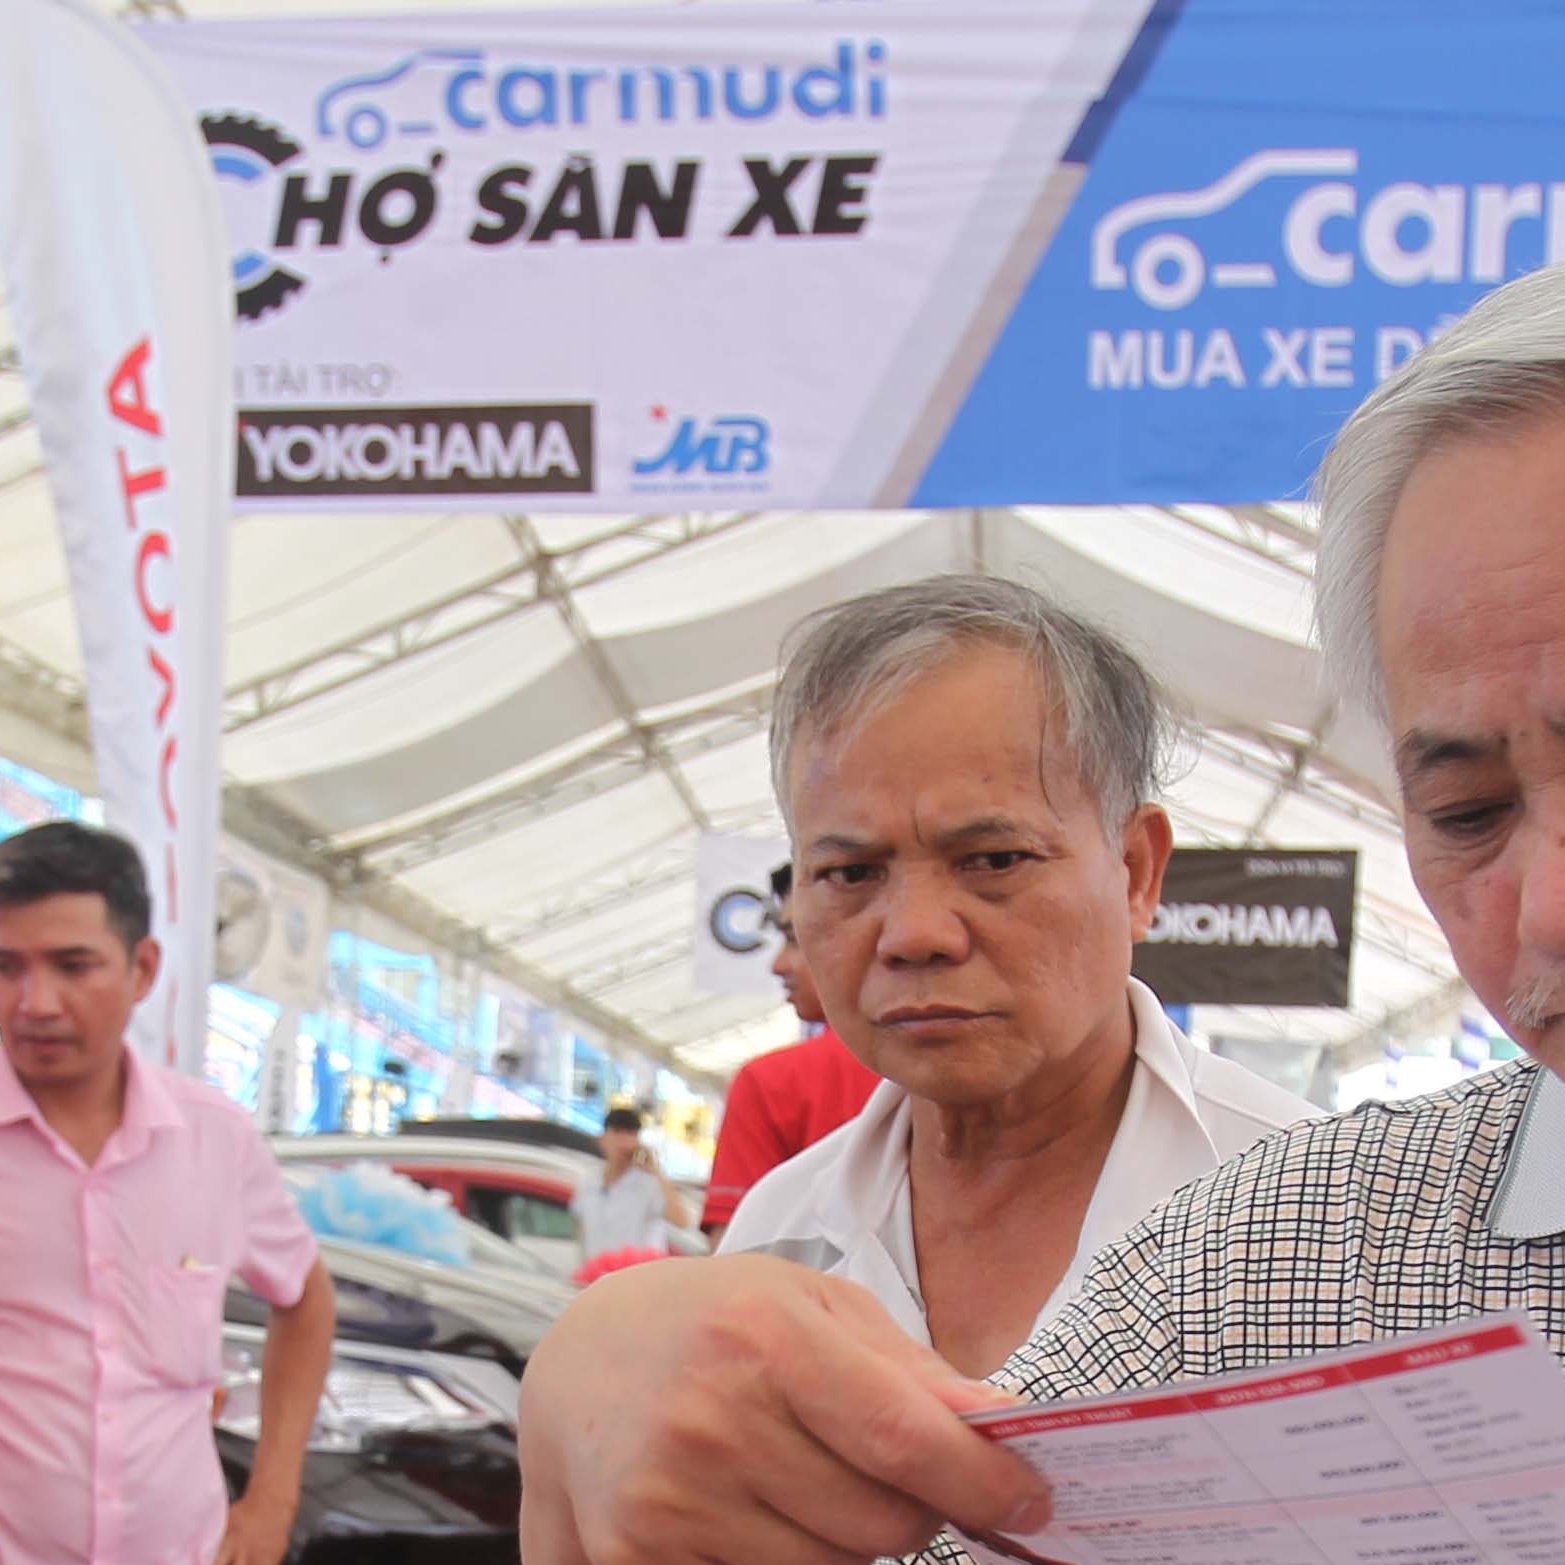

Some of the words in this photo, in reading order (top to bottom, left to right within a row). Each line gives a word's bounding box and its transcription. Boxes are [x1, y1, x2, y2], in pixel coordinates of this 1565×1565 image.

[445, 40, 887, 130] carmudi
[724, 152, 882, 238] XE
[1087, 326, 1246, 391] MUA
[1260, 326, 1355, 389] XE
[242, 420, 581, 482] YOKOHAMA
[1145, 902, 1339, 949] OKOHAMA
